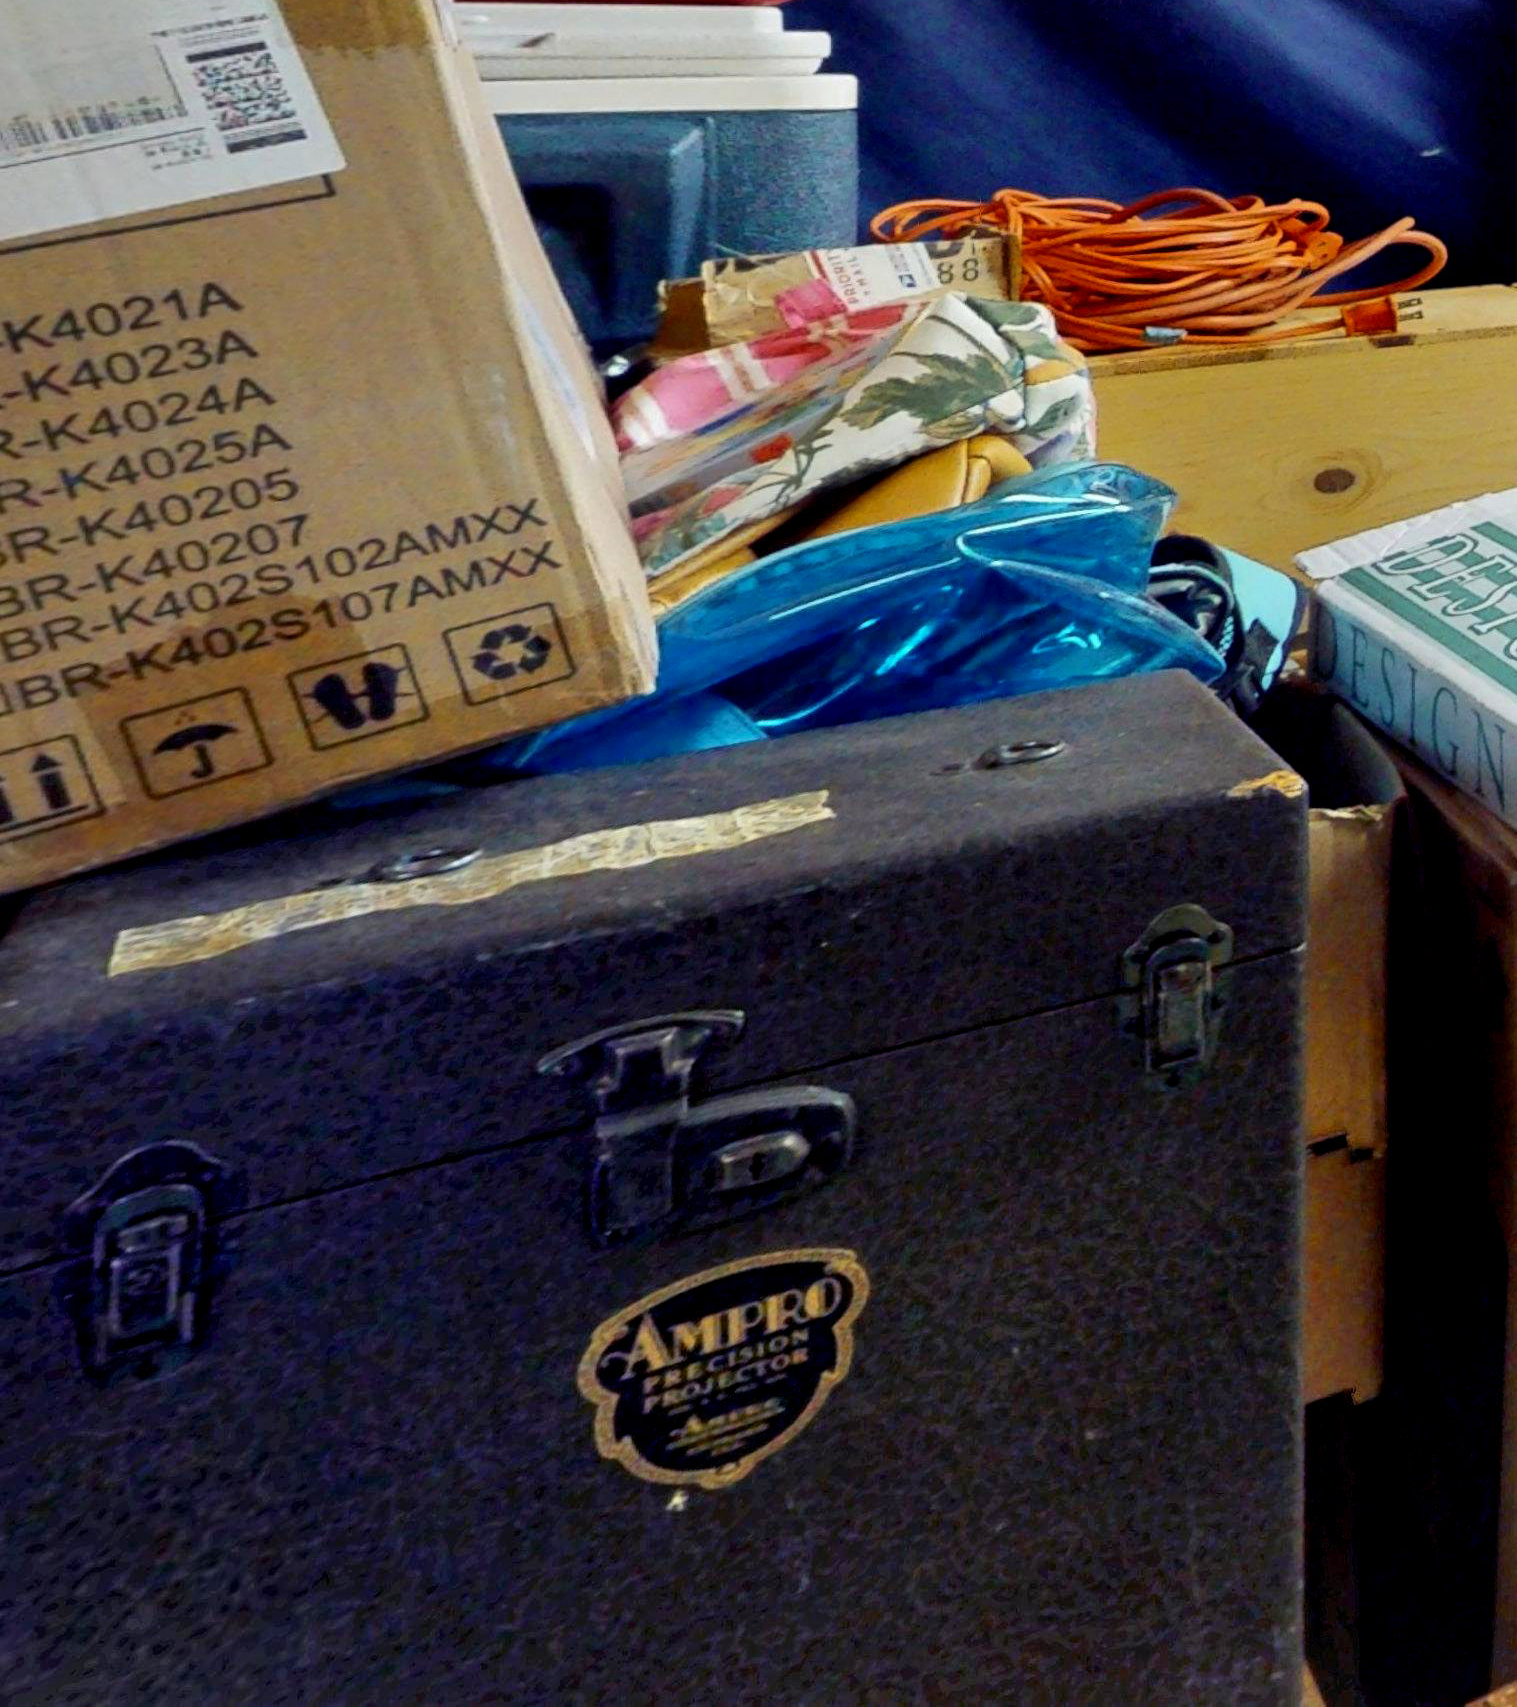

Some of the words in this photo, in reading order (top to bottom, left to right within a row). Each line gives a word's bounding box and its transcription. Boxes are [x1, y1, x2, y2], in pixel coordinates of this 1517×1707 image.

[0, 328, 259, 408] -K4023A
[0, 468, 299, 566] R-K40205
[0, 542, 563, 716] BR-K402S107AMXX
[600, 1277, 843, 1381] AMPRO
[642, 1327, 811, 1394] PRECISION
[642, 1346, 811, 1415] PROJECTOR
